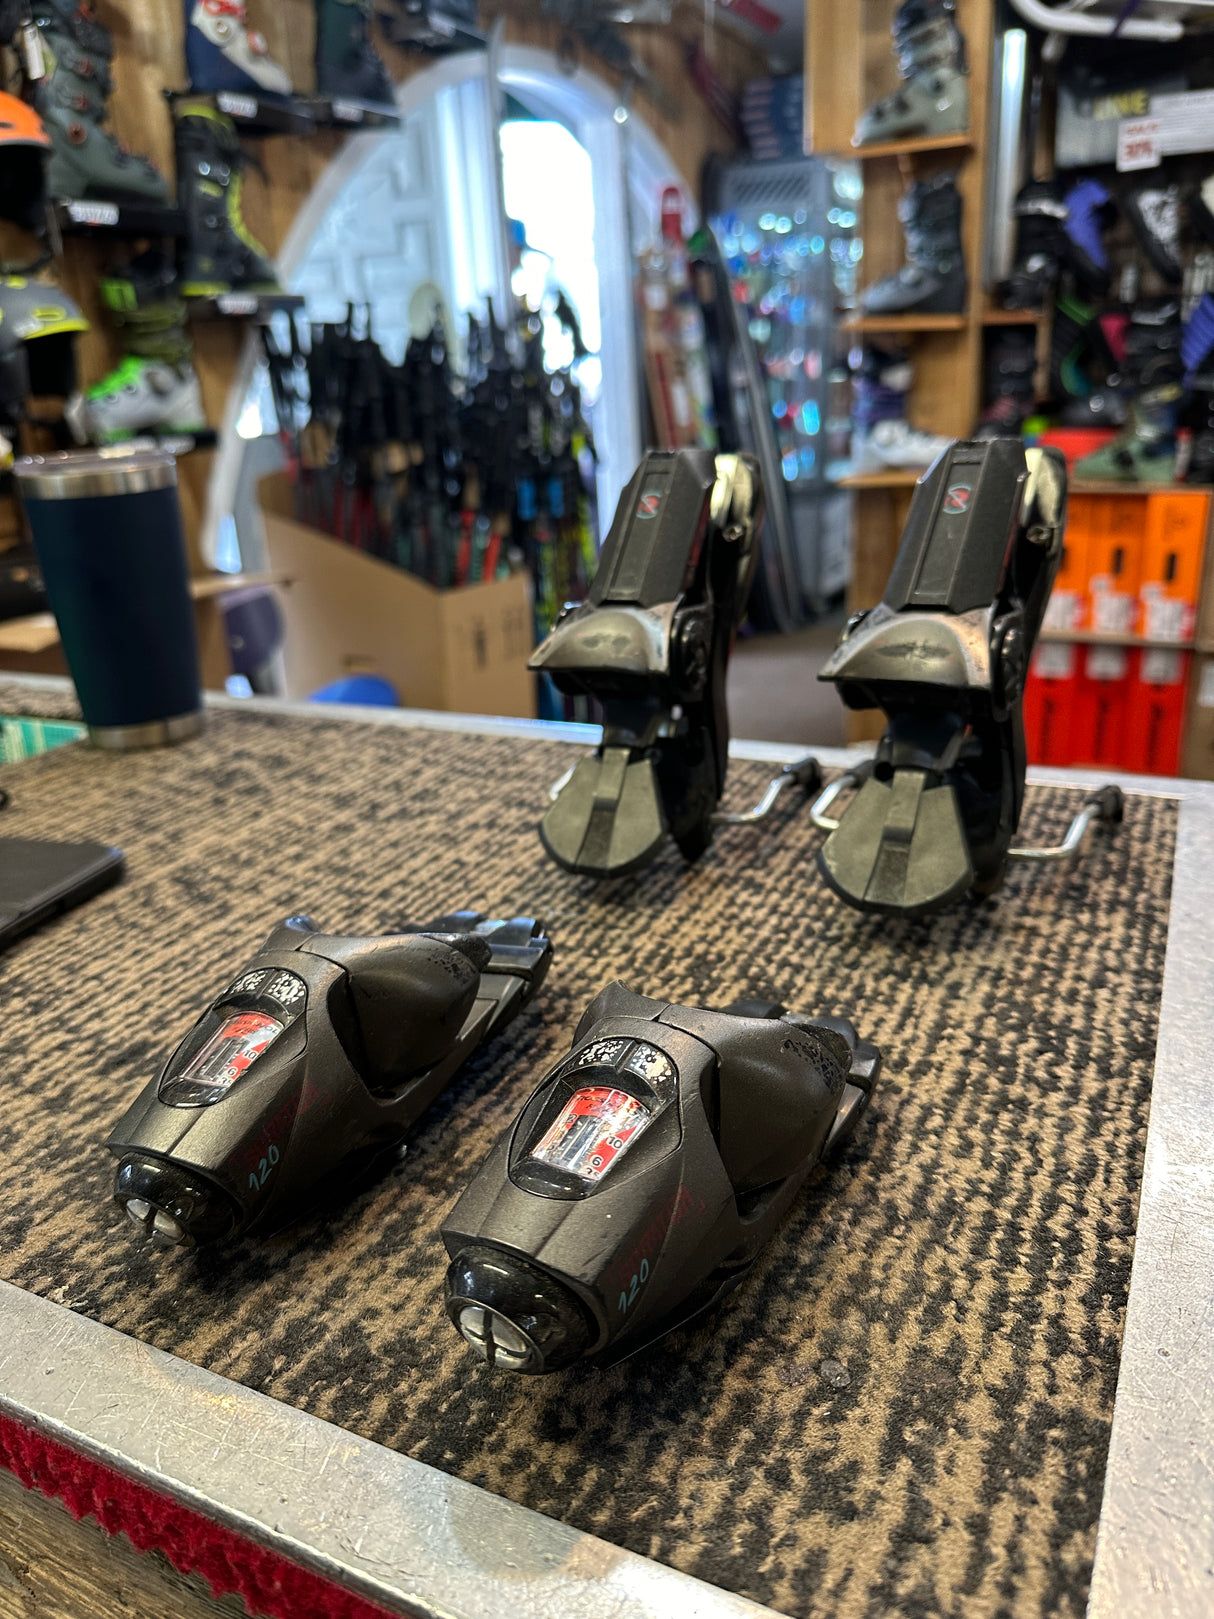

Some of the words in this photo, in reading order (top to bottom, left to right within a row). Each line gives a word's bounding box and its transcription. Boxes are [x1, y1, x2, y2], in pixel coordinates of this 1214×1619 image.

[243, 1050, 257, 1060] 10
[227, 1067, 237, 1076] 6
[607, 1136, 623, 1149] 10
[592, 1156, 603, 1167] 6
[249, 1145, 279, 1191] 120
[618, 1258, 649, 1314] 120
